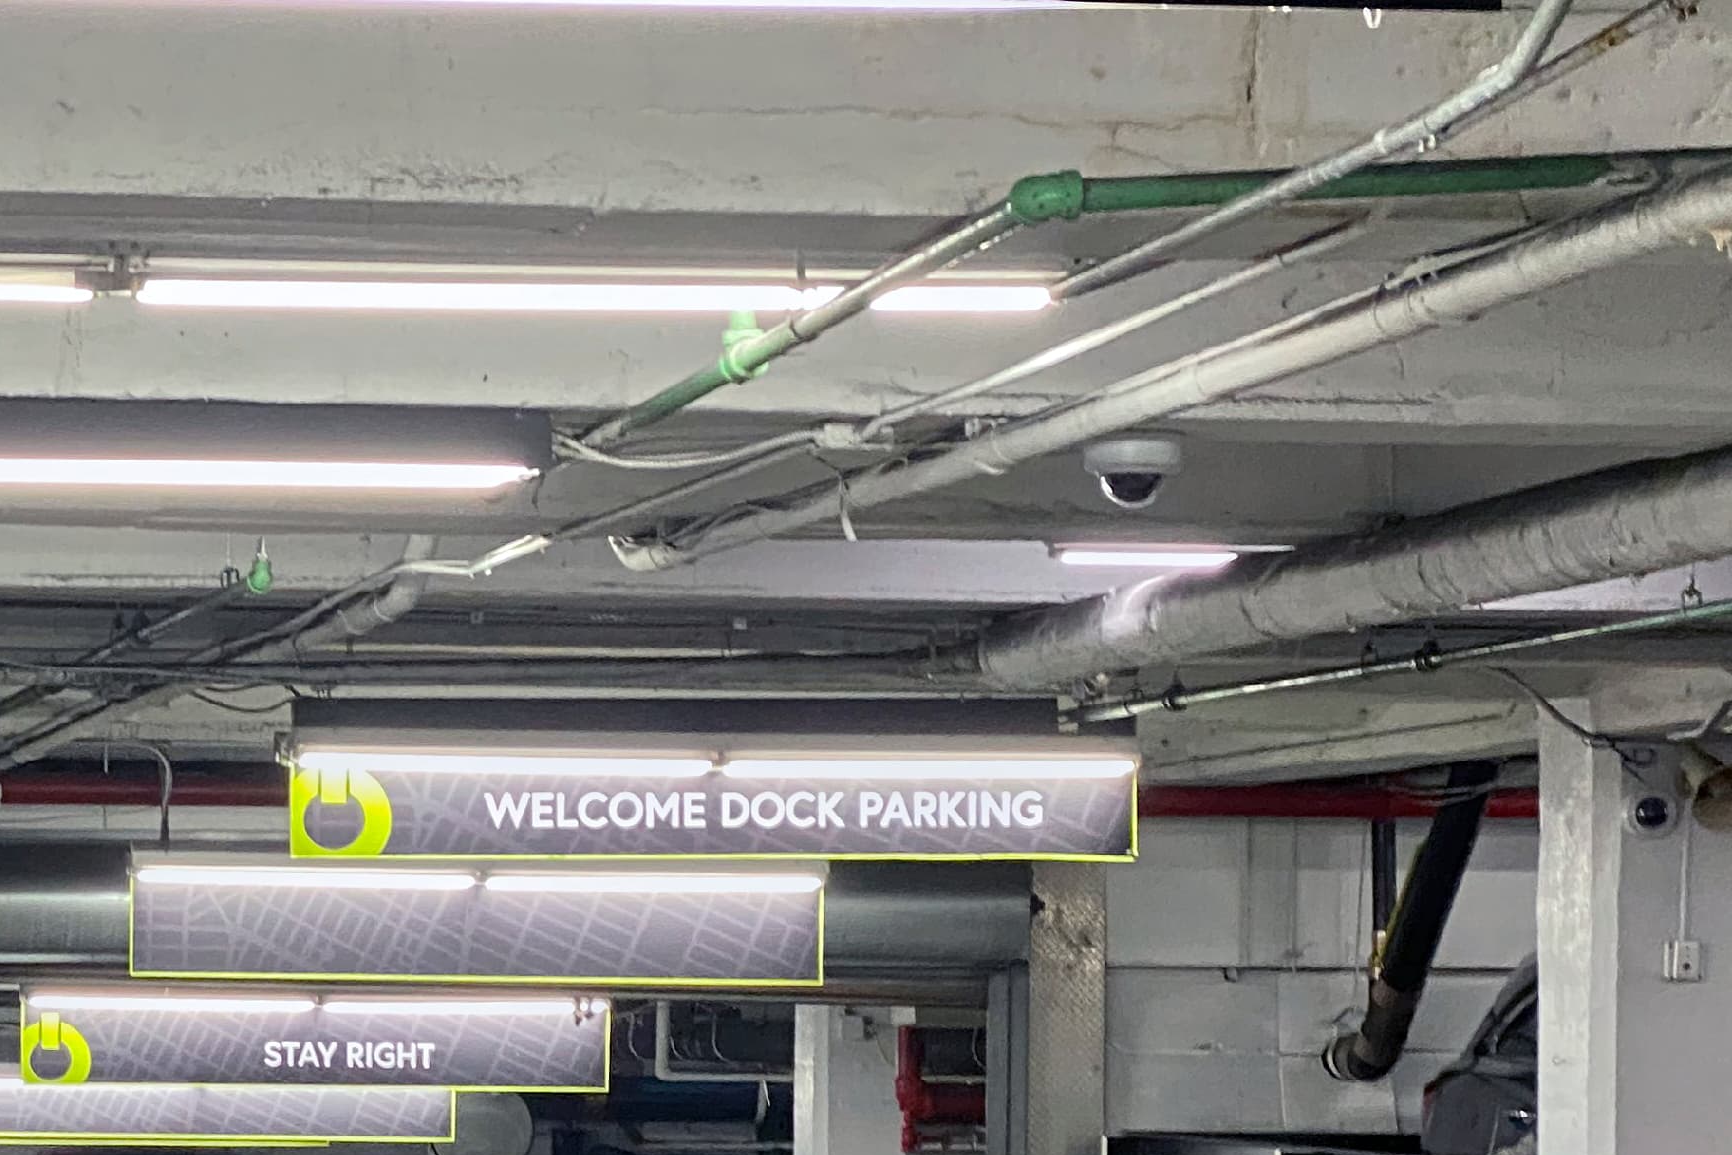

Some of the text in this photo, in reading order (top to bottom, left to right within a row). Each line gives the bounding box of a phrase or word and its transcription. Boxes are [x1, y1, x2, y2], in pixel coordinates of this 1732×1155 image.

[484, 790, 1043, 829] WELCOME DOCK PARKING
[264, 1041, 435, 1069] STAY RIGHT
